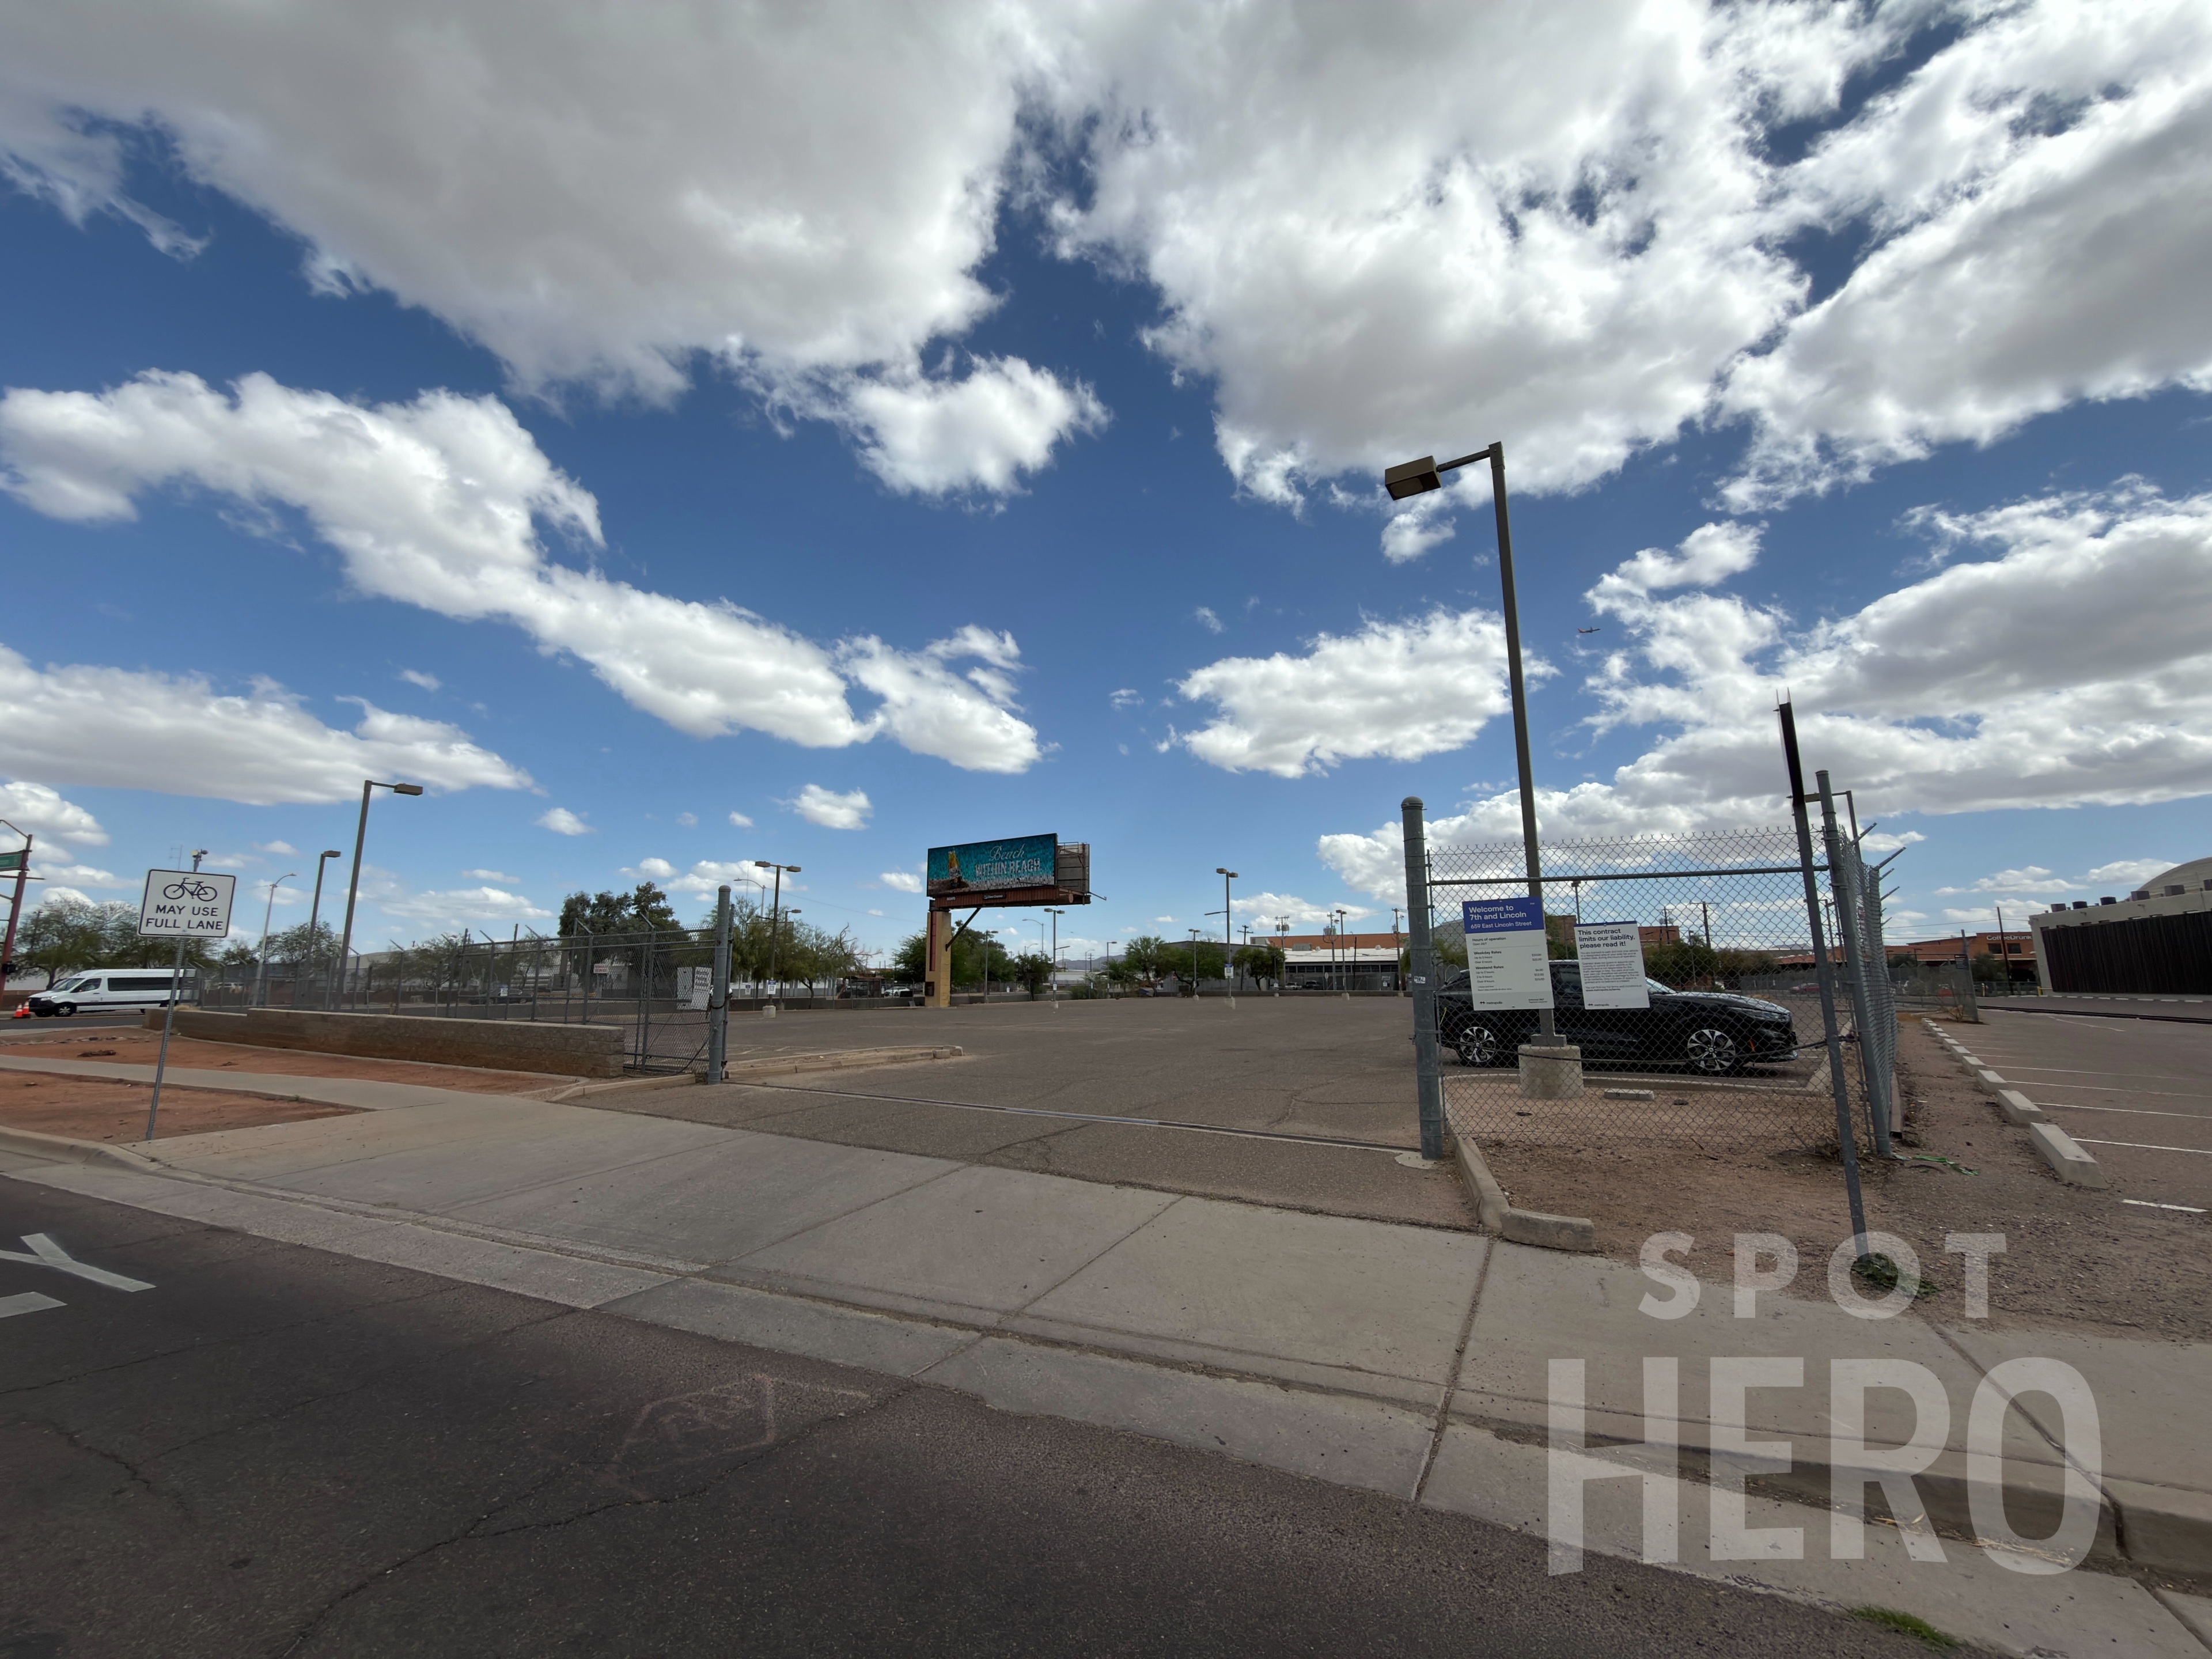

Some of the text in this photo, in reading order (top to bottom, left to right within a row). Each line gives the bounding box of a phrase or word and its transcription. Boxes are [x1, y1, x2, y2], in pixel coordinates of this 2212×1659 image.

[989, 843, 1025, 861] Beach
[975, 863, 1007, 876] WITHIN
[1009, 858, 1040, 873] REACH
[156, 905, 218, 916] MAY USE
[146, 918, 224, 930] FULL LANE
